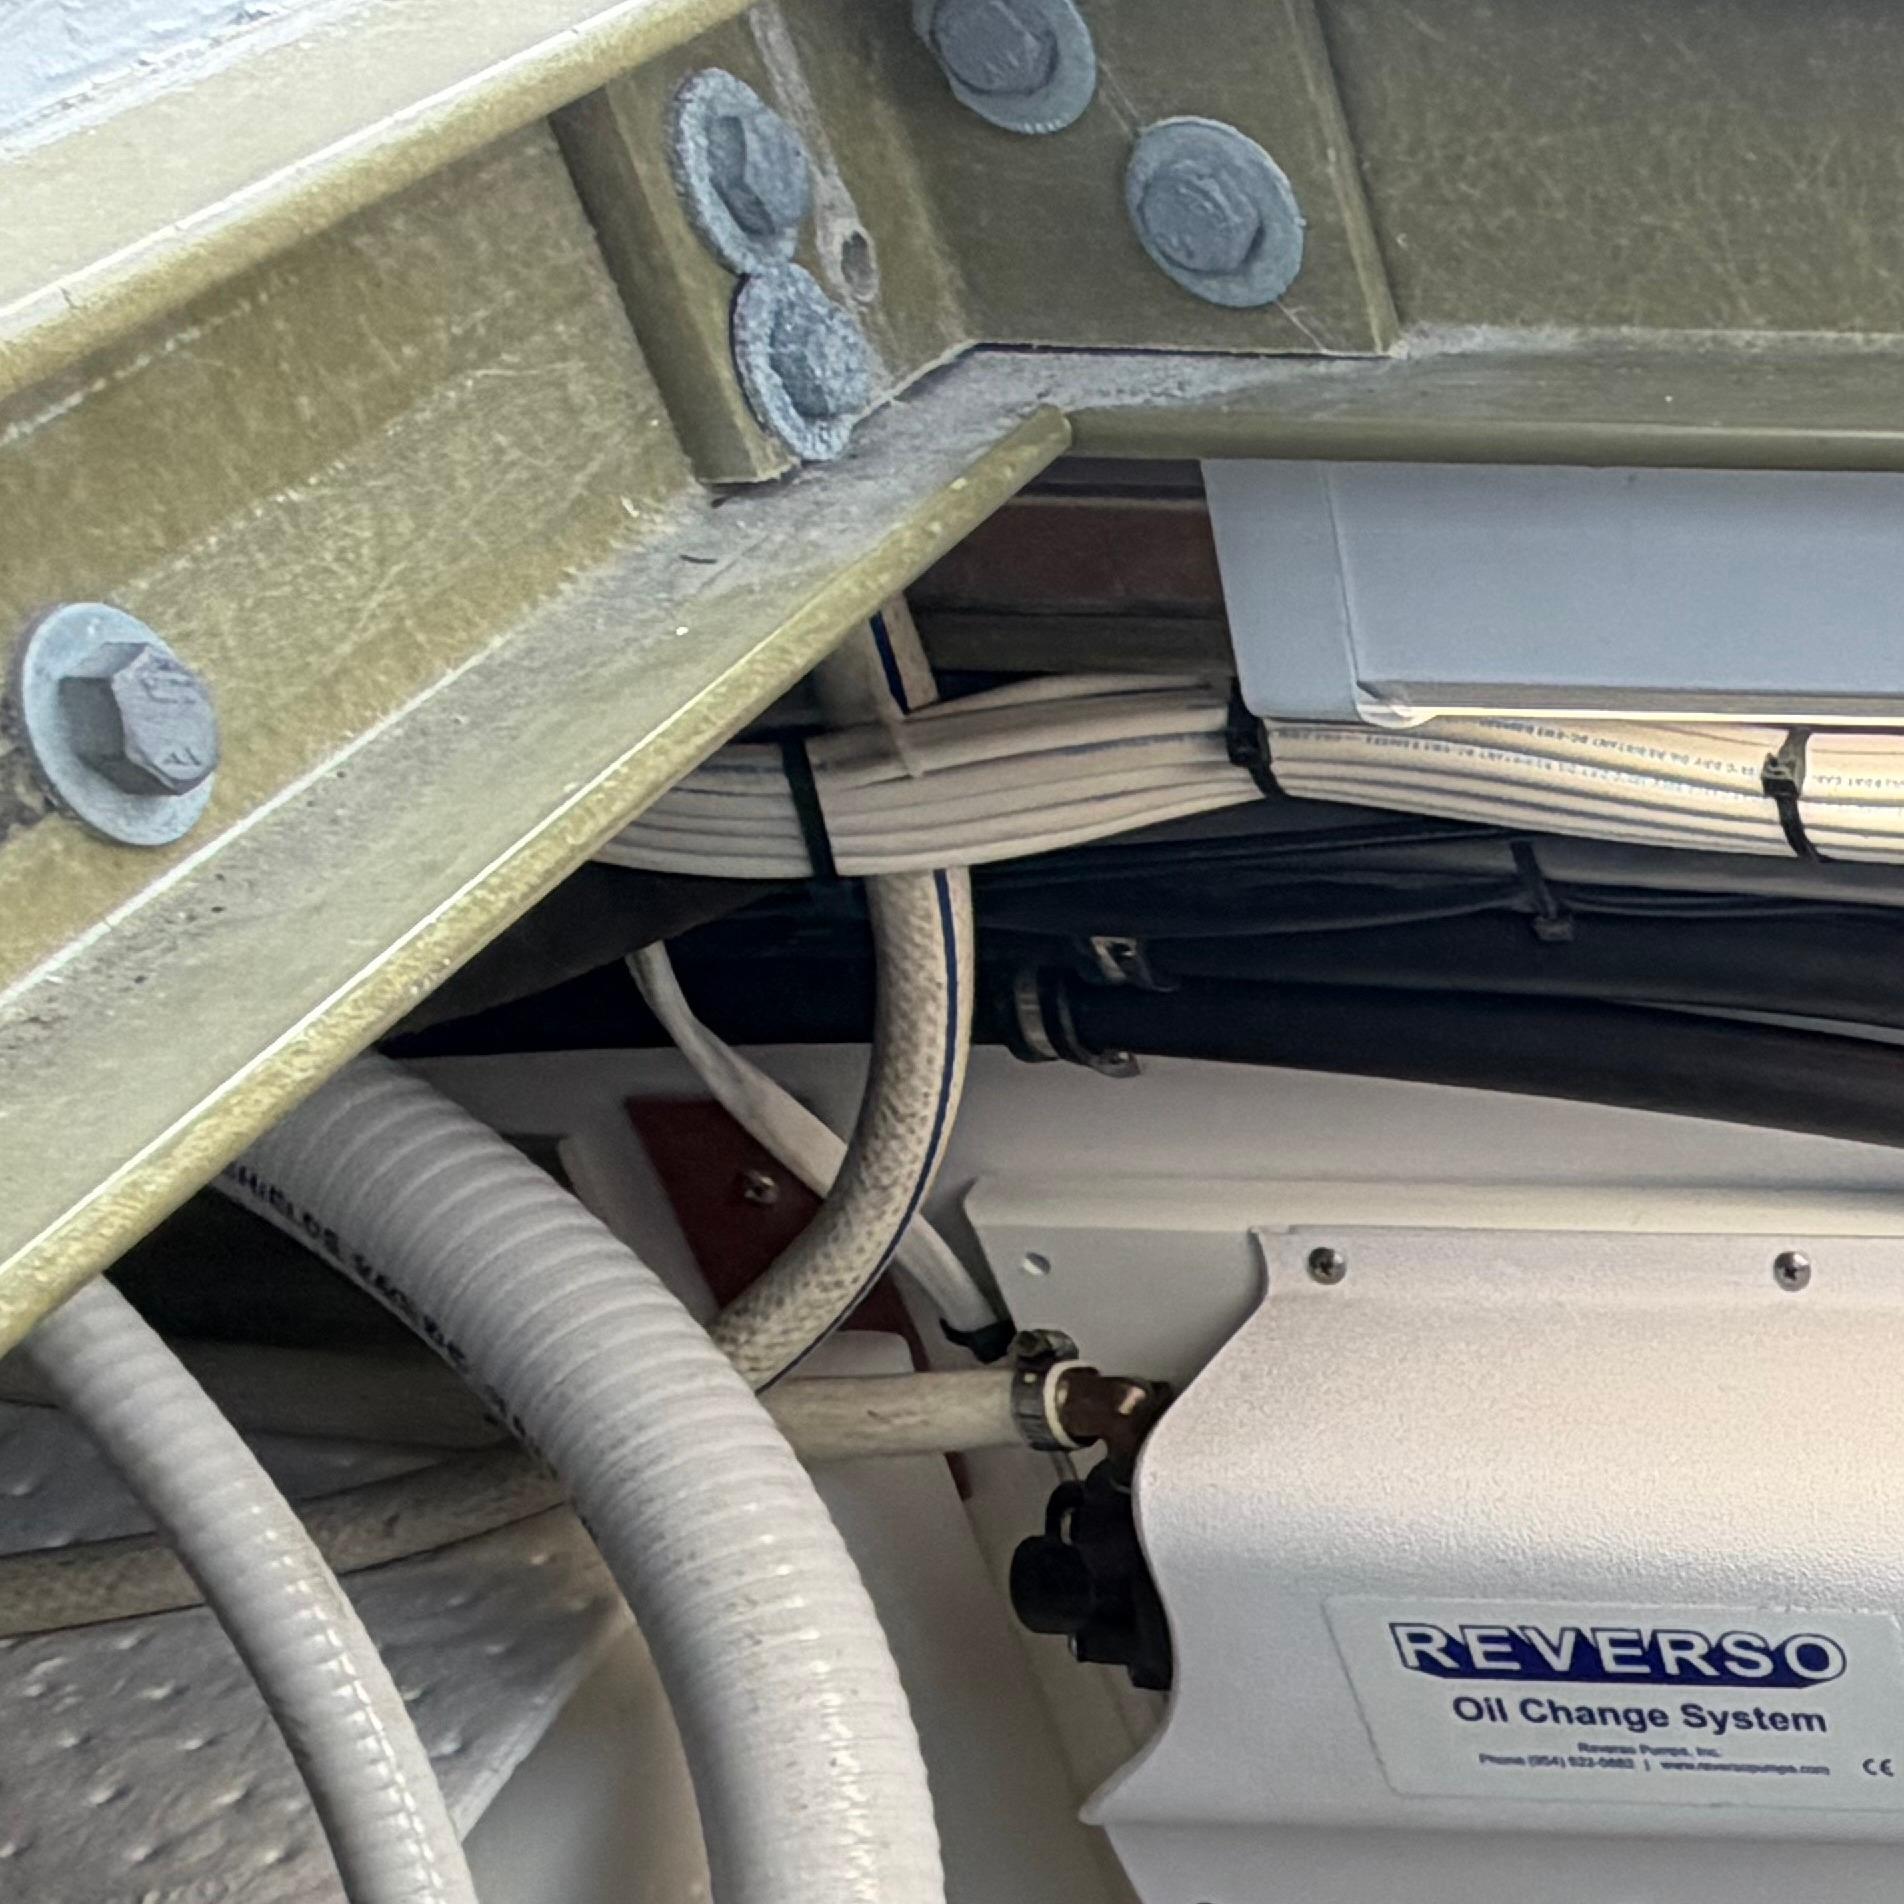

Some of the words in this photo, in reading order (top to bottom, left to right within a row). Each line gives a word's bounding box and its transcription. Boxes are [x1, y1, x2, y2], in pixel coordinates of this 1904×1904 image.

[1389, 1621, 1848, 1689] REVERSO
[1451, 1696, 1508, 1724] Oil
[1519, 1697, 1671, 1734] Change
[1681, 1703, 1828, 1736] System
